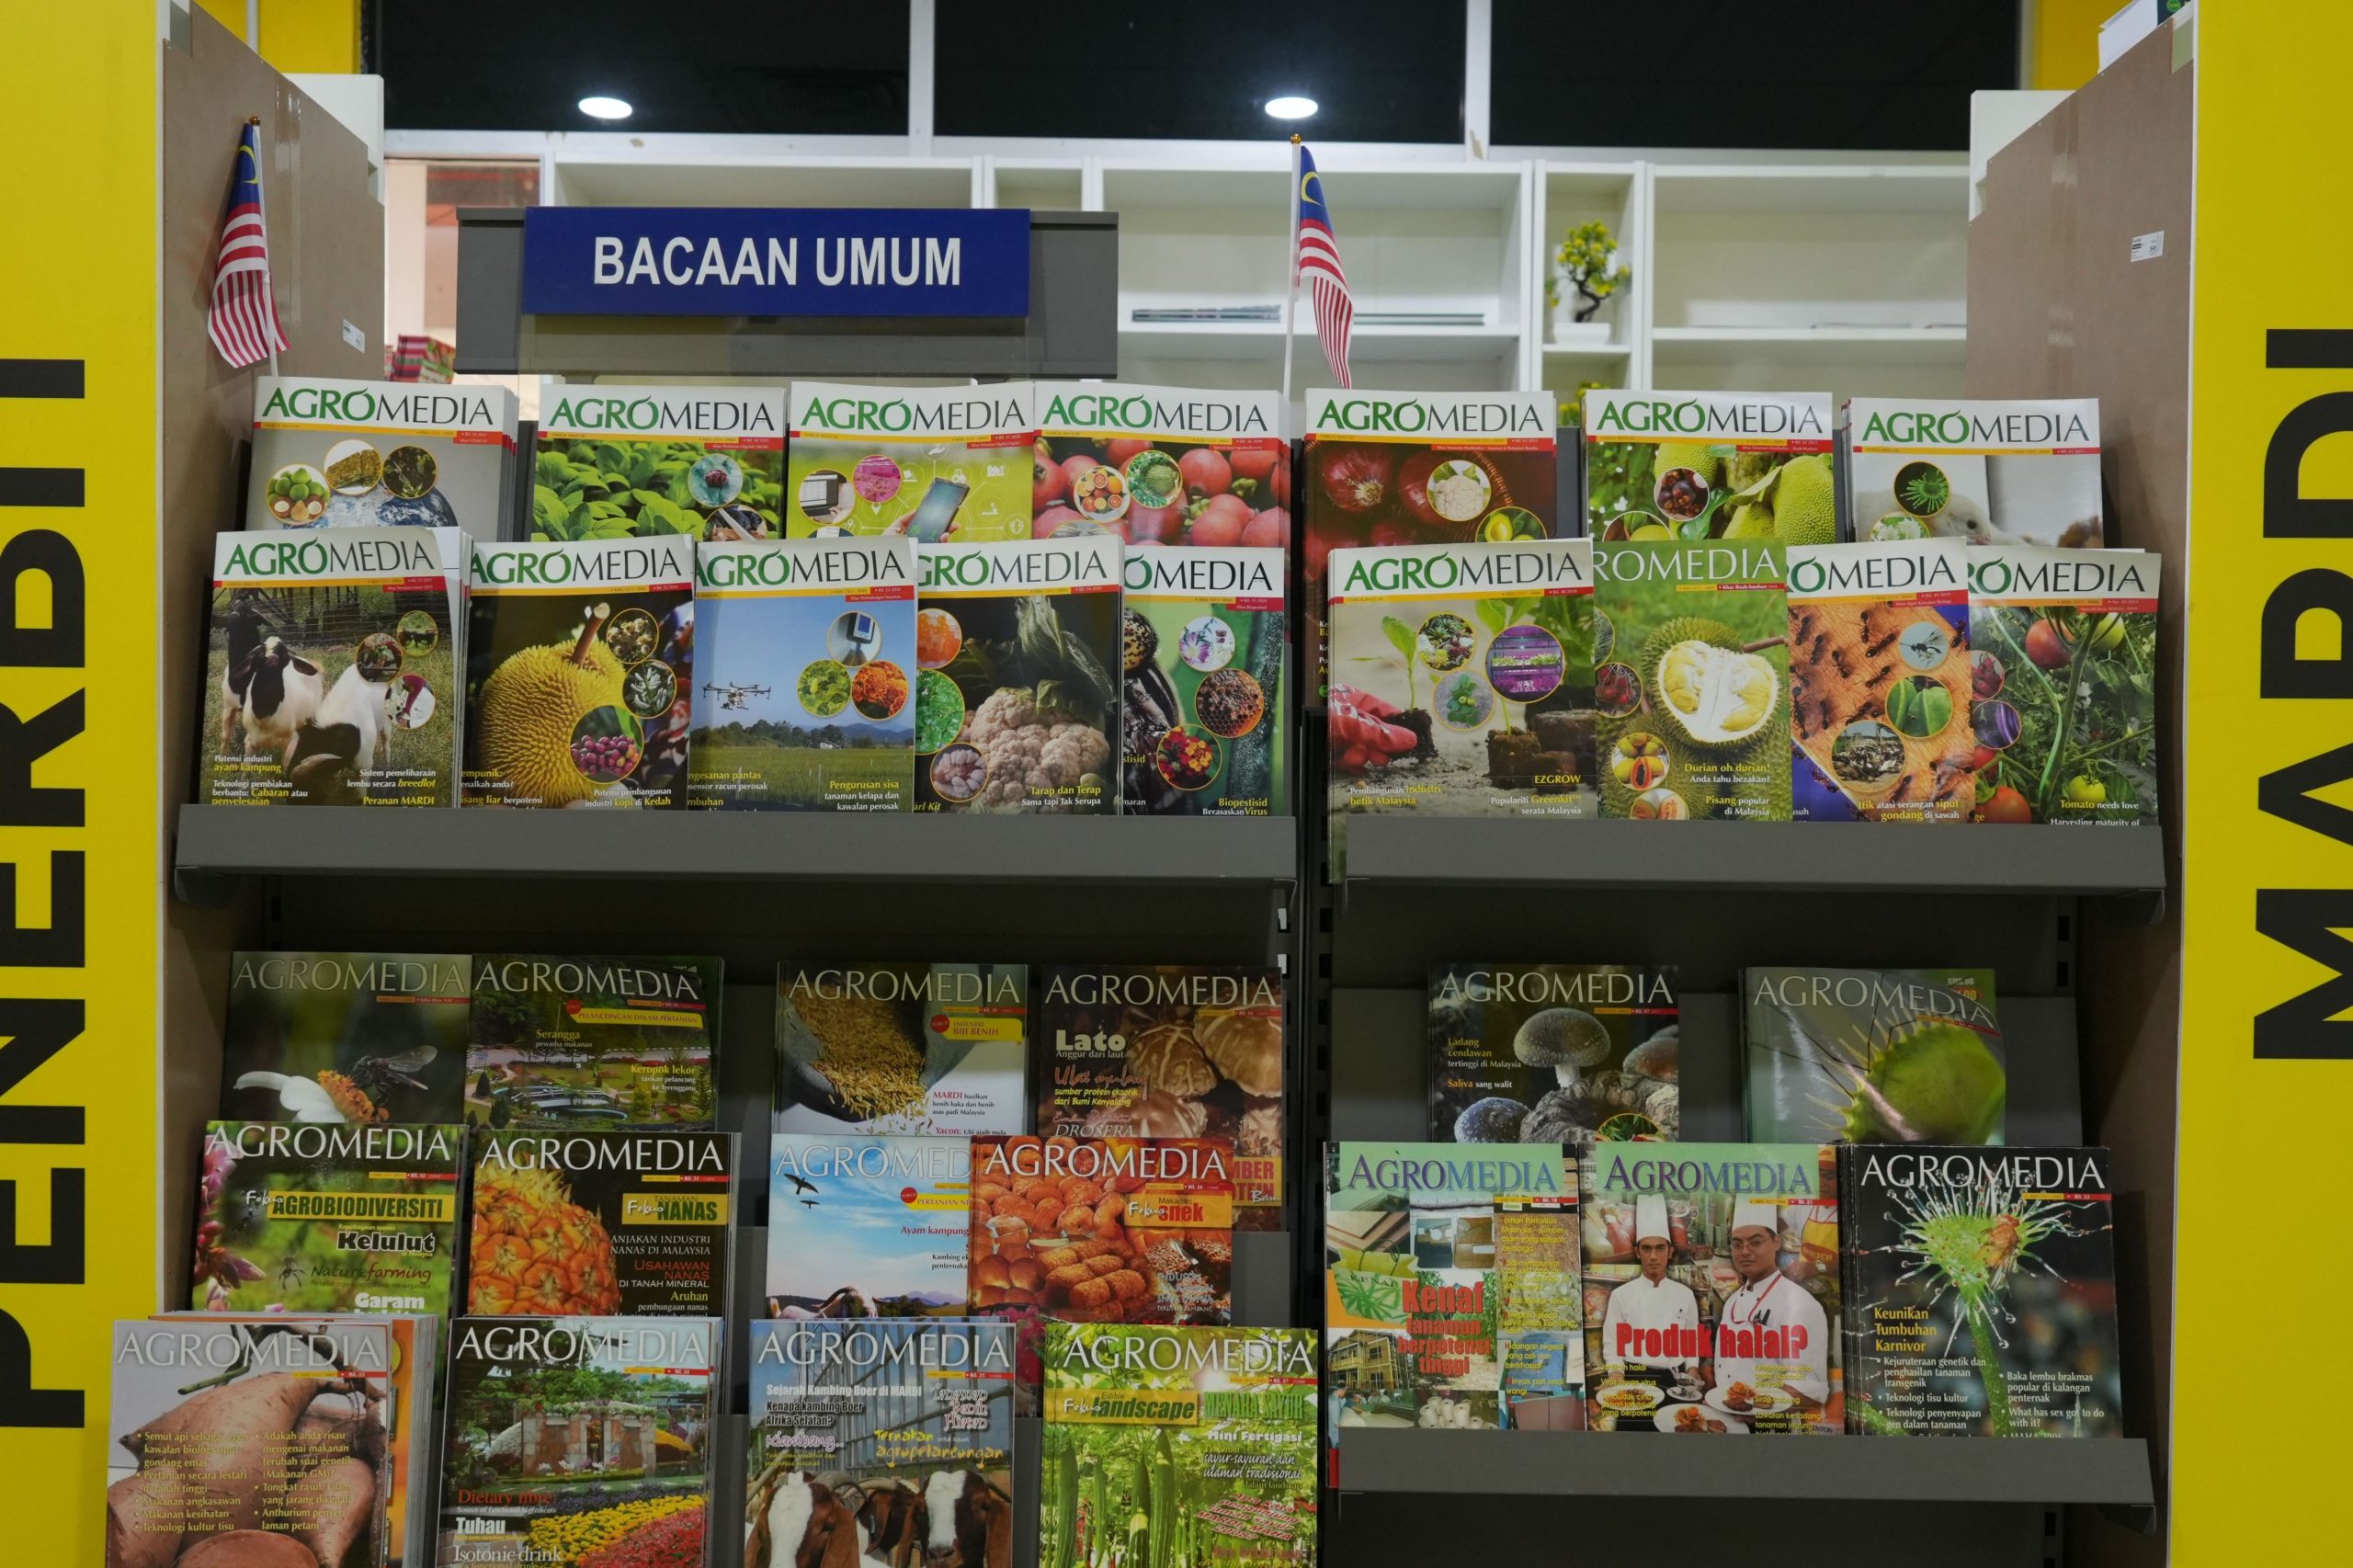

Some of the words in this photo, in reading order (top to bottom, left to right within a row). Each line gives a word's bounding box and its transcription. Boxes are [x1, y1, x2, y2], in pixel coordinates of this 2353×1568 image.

[594, 236, 798, 286] BACAAN
[815, 236, 961, 286] UMUM
[262, 386, 493, 425] AGROMEDIA
[549, 395, 774, 430] AGROMEDIA
[801, 397, 1026, 431] AGROMEDIA
[1042, 394, 1267, 432] AGROMEDIA
[1316, 398, 1544, 432] AGROMEDIA
[1597, 398, 1823, 433] AGROMEDIA
[1862, 409, 2090, 443] AGROMEDIA
[223, 537, 435, 575] AGROMEDIA
[471, 547, 681, 584] AGROMEDIA
[918, 550, 1107, 587] GROMEDIA
[1594, 548, 1779, 581] ROMEDIA
[1125, 553, 1272, 591] OMEDIA
[1344, 551, 1582, 591] AGROMEDIA
[240, 764, 281, 773] kampung
[386, 769, 436, 778] pemeliharaan
[1684, 763, 1717, 772] Durian
[1721, 763, 1733, 772] oh
[1735, 763, 1770, 772] durian!
[213, 780, 249, 789] Teknologi
[251, 780, 292, 789] pembiakan
[398, 779, 436, 788] breedlot
[830, 780, 880, 790] Pengurusan
[883, 780, 899, 789] sisa
[1534, 775, 1581, 784] EZGROW
[1690, 775, 1711, 783] Anda
[1713, 775, 1731, 783] tahu
[1733, 775, 1770, 783] bezakan?
[251, 789, 289, 797] Cabaran
[621, 789, 672, 797] pembangunan
[1030, 786, 1055, 797] Tarap
[1058, 785, 1074, 795] dan
[1077, 785, 1102, 796] Terap
[1349, 787, 1404, 795] Pembangunan
[1406, 784, 1441, 793] industri
[363, 797, 398, 805] Peranan
[401, 797, 435, 805] MARDI
[504, 797, 543, 805] berpotensi
[615, 799, 633, 807] kopi
[644, 797, 671, 806] Kedah
[858, 792, 882, 801] kelapa
[1021, 799, 1041, 807] Sama
[1044, 799, 1059, 807] tapi
[1075, 797, 1101, 807] Serupa
[1376, 796, 1416, 805] Malaysia
[1491, 796, 1529, 806] Populariti
[1706, 795, 1736, 806] Pisang
[1738, 796, 1769, 806] popular
[870, 802, 899, 812] perosak
[1218, 798, 1267, 809] Biopestisid
[1858, 800, 1875, 809] Itik
[1877, 801, 1895, 809] atasi
[1897, 800, 1933, 810] serangan
[1935, 799, 1959, 811] siput
[2060, 800, 2095, 809] Tomato
[2121, 801, 2139, 810] love
[1245, 807, 1267, 816] Virus
[1521, 806, 1545, 815] serata
[1547, 806, 1582, 816] Malaysia
[1724, 806, 1732, 815] di
[1734, 806, 1769, 817] Malaysia
[1881, 809, 1923, 822] gondang
[1925, 811, 1933, 819] di
[1935, 811, 1960, 819] sawah
[233, 959, 465, 993] AGROMEDIA
[475, 961, 699, 1000] AGROMEDIA
[789, 969, 1020, 1003] AGROMEDIA
[1045, 974, 1277, 1006] AGROMEDIA
[1438, 971, 1674, 1004] AGROMEDIA
[1754, 975, 1995, 1028] AGROMEDIA
[536, 1029, 580, 1040] Serangga
[971, 1028, 999, 1036] BENIH
[1056, 1029, 1126, 1051] Lato
[1448, 1038, 1480, 1048] Ladang
[1449, 1049, 1492, 1057] cendawan
[631, 1064, 669, 1075] Keropok
[672, 1064, 696, 1074] lekor
[1448, 1079, 1473, 1088] Saliva
[1475, 1081, 1492, 1089] sang
[1494, 1079, 1512, 1088] walit
[933, 1091, 962, 1099] MARDI
[206, 1125, 450, 1161] AGROMEDIA
[480, 1137, 723, 1171] AGROMEDIA
[776, 1145, 971, 1179] AGROMED
[984, 1143, 1227, 1179] AGROMEDIA
[1347, 1153, 1557, 1192] AGROMEDIA
[1603, 1153, 1813, 1193] AGROMEDIA
[1860, 1154, 2105, 1188] AGROMEDIA
[273, 1196, 443, 1218] AGROBIODIVERSITI
[657, 1201, 717, 1221] NANAS
[1158, 1203, 1204, 1222] snek
[901, 1226, 926, 1234] Ayam
[927, 1226, 970, 1236] kampung
[336, 1232, 435, 1252] Kelulut
[611, 1235, 657, 1244] ANJAKAN
[661, 1235, 710, 1244] INDUSTRI
[610, 1245, 645, 1255] NANAS
[648, 1246, 661, 1255] DI
[664, 1246, 710, 1255] MALAYSIA
[355, 1292, 425, 1310] Garam
[670, 1291, 709, 1301] Aruhan
[1402, 1280, 1484, 1314] Kenaf
[1875, 1307, 1928, 1320] Keunikan
[1875, 1324, 1938, 1336] Tumbuhan
[456, 1326, 704, 1363] AGROMEDIA
[1616, 1323, 1714, 1358] Produk
[1720, 1324, 1808, 1358] halal?
[1875, 1340, 1927, 1352] Karnivor
[117, 1331, 381, 1368] AGROMEDIA
[757, 1331, 1011, 1368] AGROMEDIA
[1063, 1336, 1313, 1373] AGROMEDIA
[1884, 1358, 1937, 1367] Kejuruteraan
[1938, 1358, 1969, 1368] genetik
[1971, 1358, 1986, 1366] dan
[2007, 1371, 2028, 1381] Baka
[2029, 1372, 2055, 1381] lembu
[2058, 1372, 2094, 1381] brakmas
[880, 1385, 889, 1395] di
[891, 1386, 922, 1397] MARDI
[1886, 1393, 1925, 1403] Teknologi
[1927, 1393, 1941, 1403] tisu
[1943, 1393, 1969, 1403] kultur
[1091, 1396, 1195, 1420] landscape
[186, 1509, 230, 1518] kesihatan
[456, 1517, 506, 1535] Tuhau
